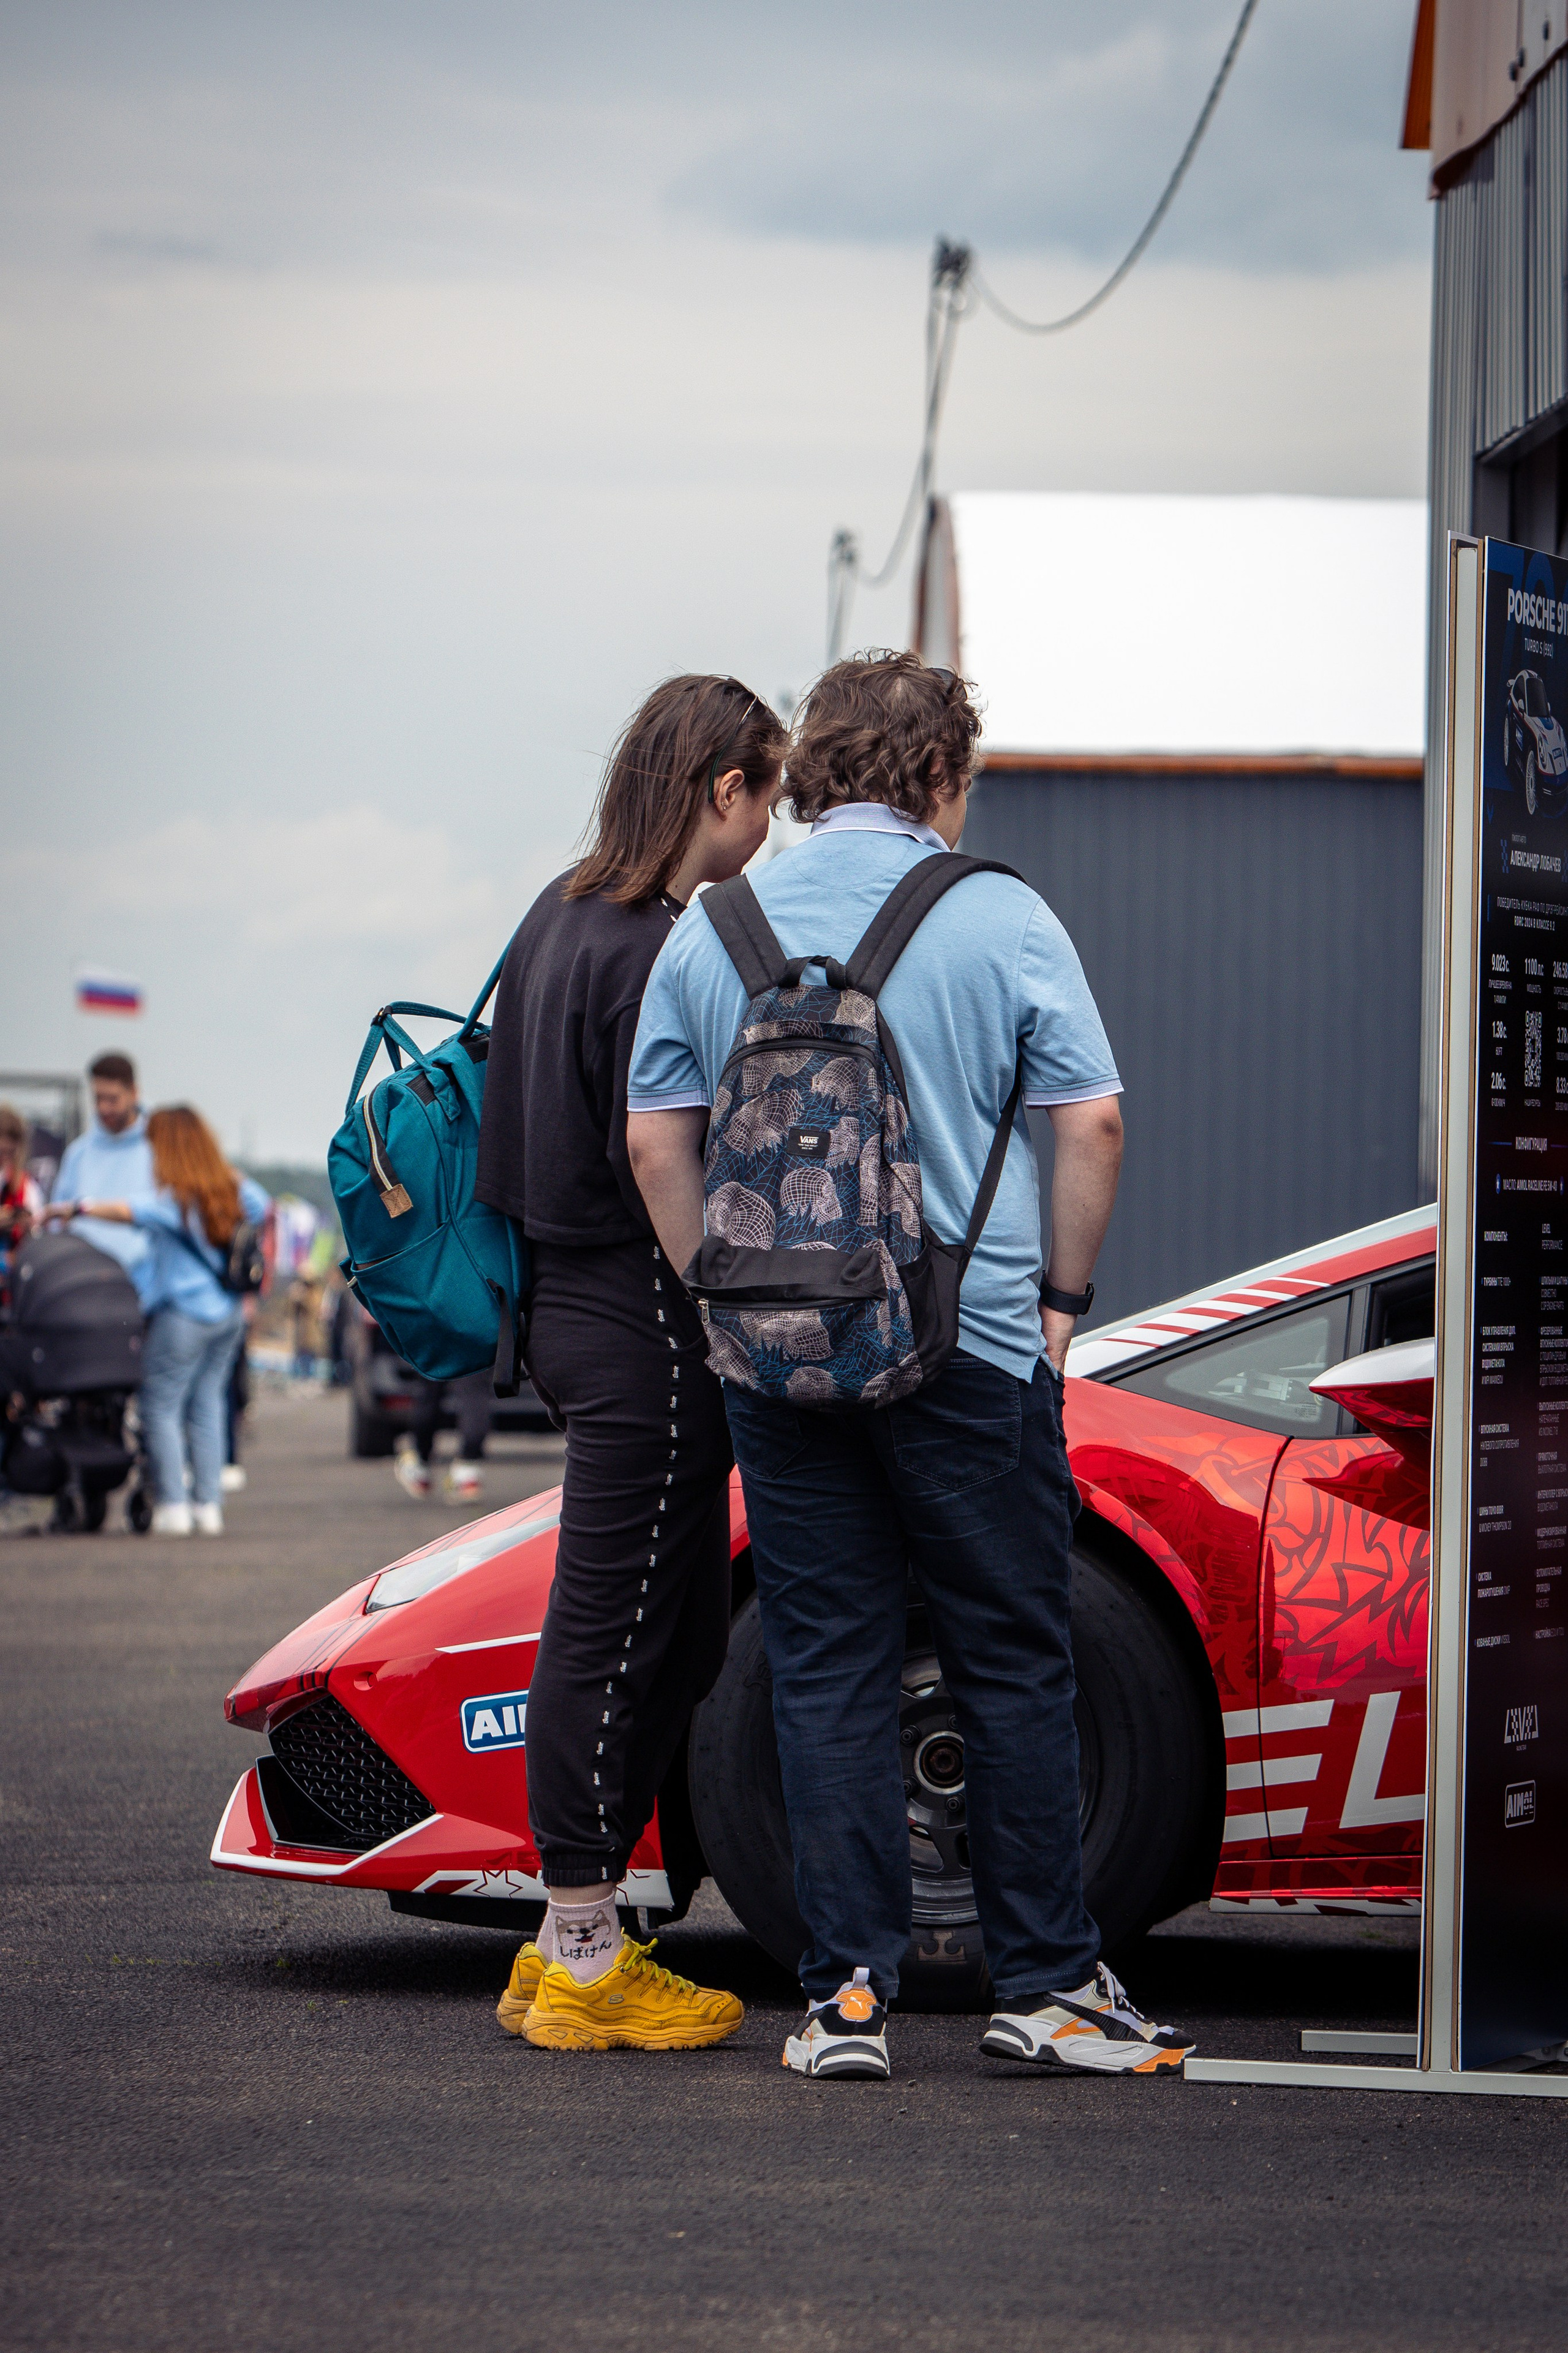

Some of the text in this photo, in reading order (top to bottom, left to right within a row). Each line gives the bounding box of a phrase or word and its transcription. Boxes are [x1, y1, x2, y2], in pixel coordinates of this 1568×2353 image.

[1507, 587, 1555, 633] PORSCHE
[1525, 638, 1539, 654] TURBO
[1544, 642, 1554, 659] (992)
[1510, 850, 1561, 873] АЛЕКСАНДР ЛОБАЧЕВ
[1491, 953, 1506, 972] 9.023
[1525, 957, 1537, 975] 1100
[1492, 1021, 1503, 1038] 1.38
[1491, 1071, 1502, 1090] 2.06
[1556, 1076, 1566, 1094] 8.33
[800, 1135, 819, 1144] VANS
[1515, 1136, 1547, 1154] КОНФИГУРАЦИЯ
[1478, 1571, 1492, 1582] СИСТЕМА
[560, 1939, 612, 1960] しばけん
